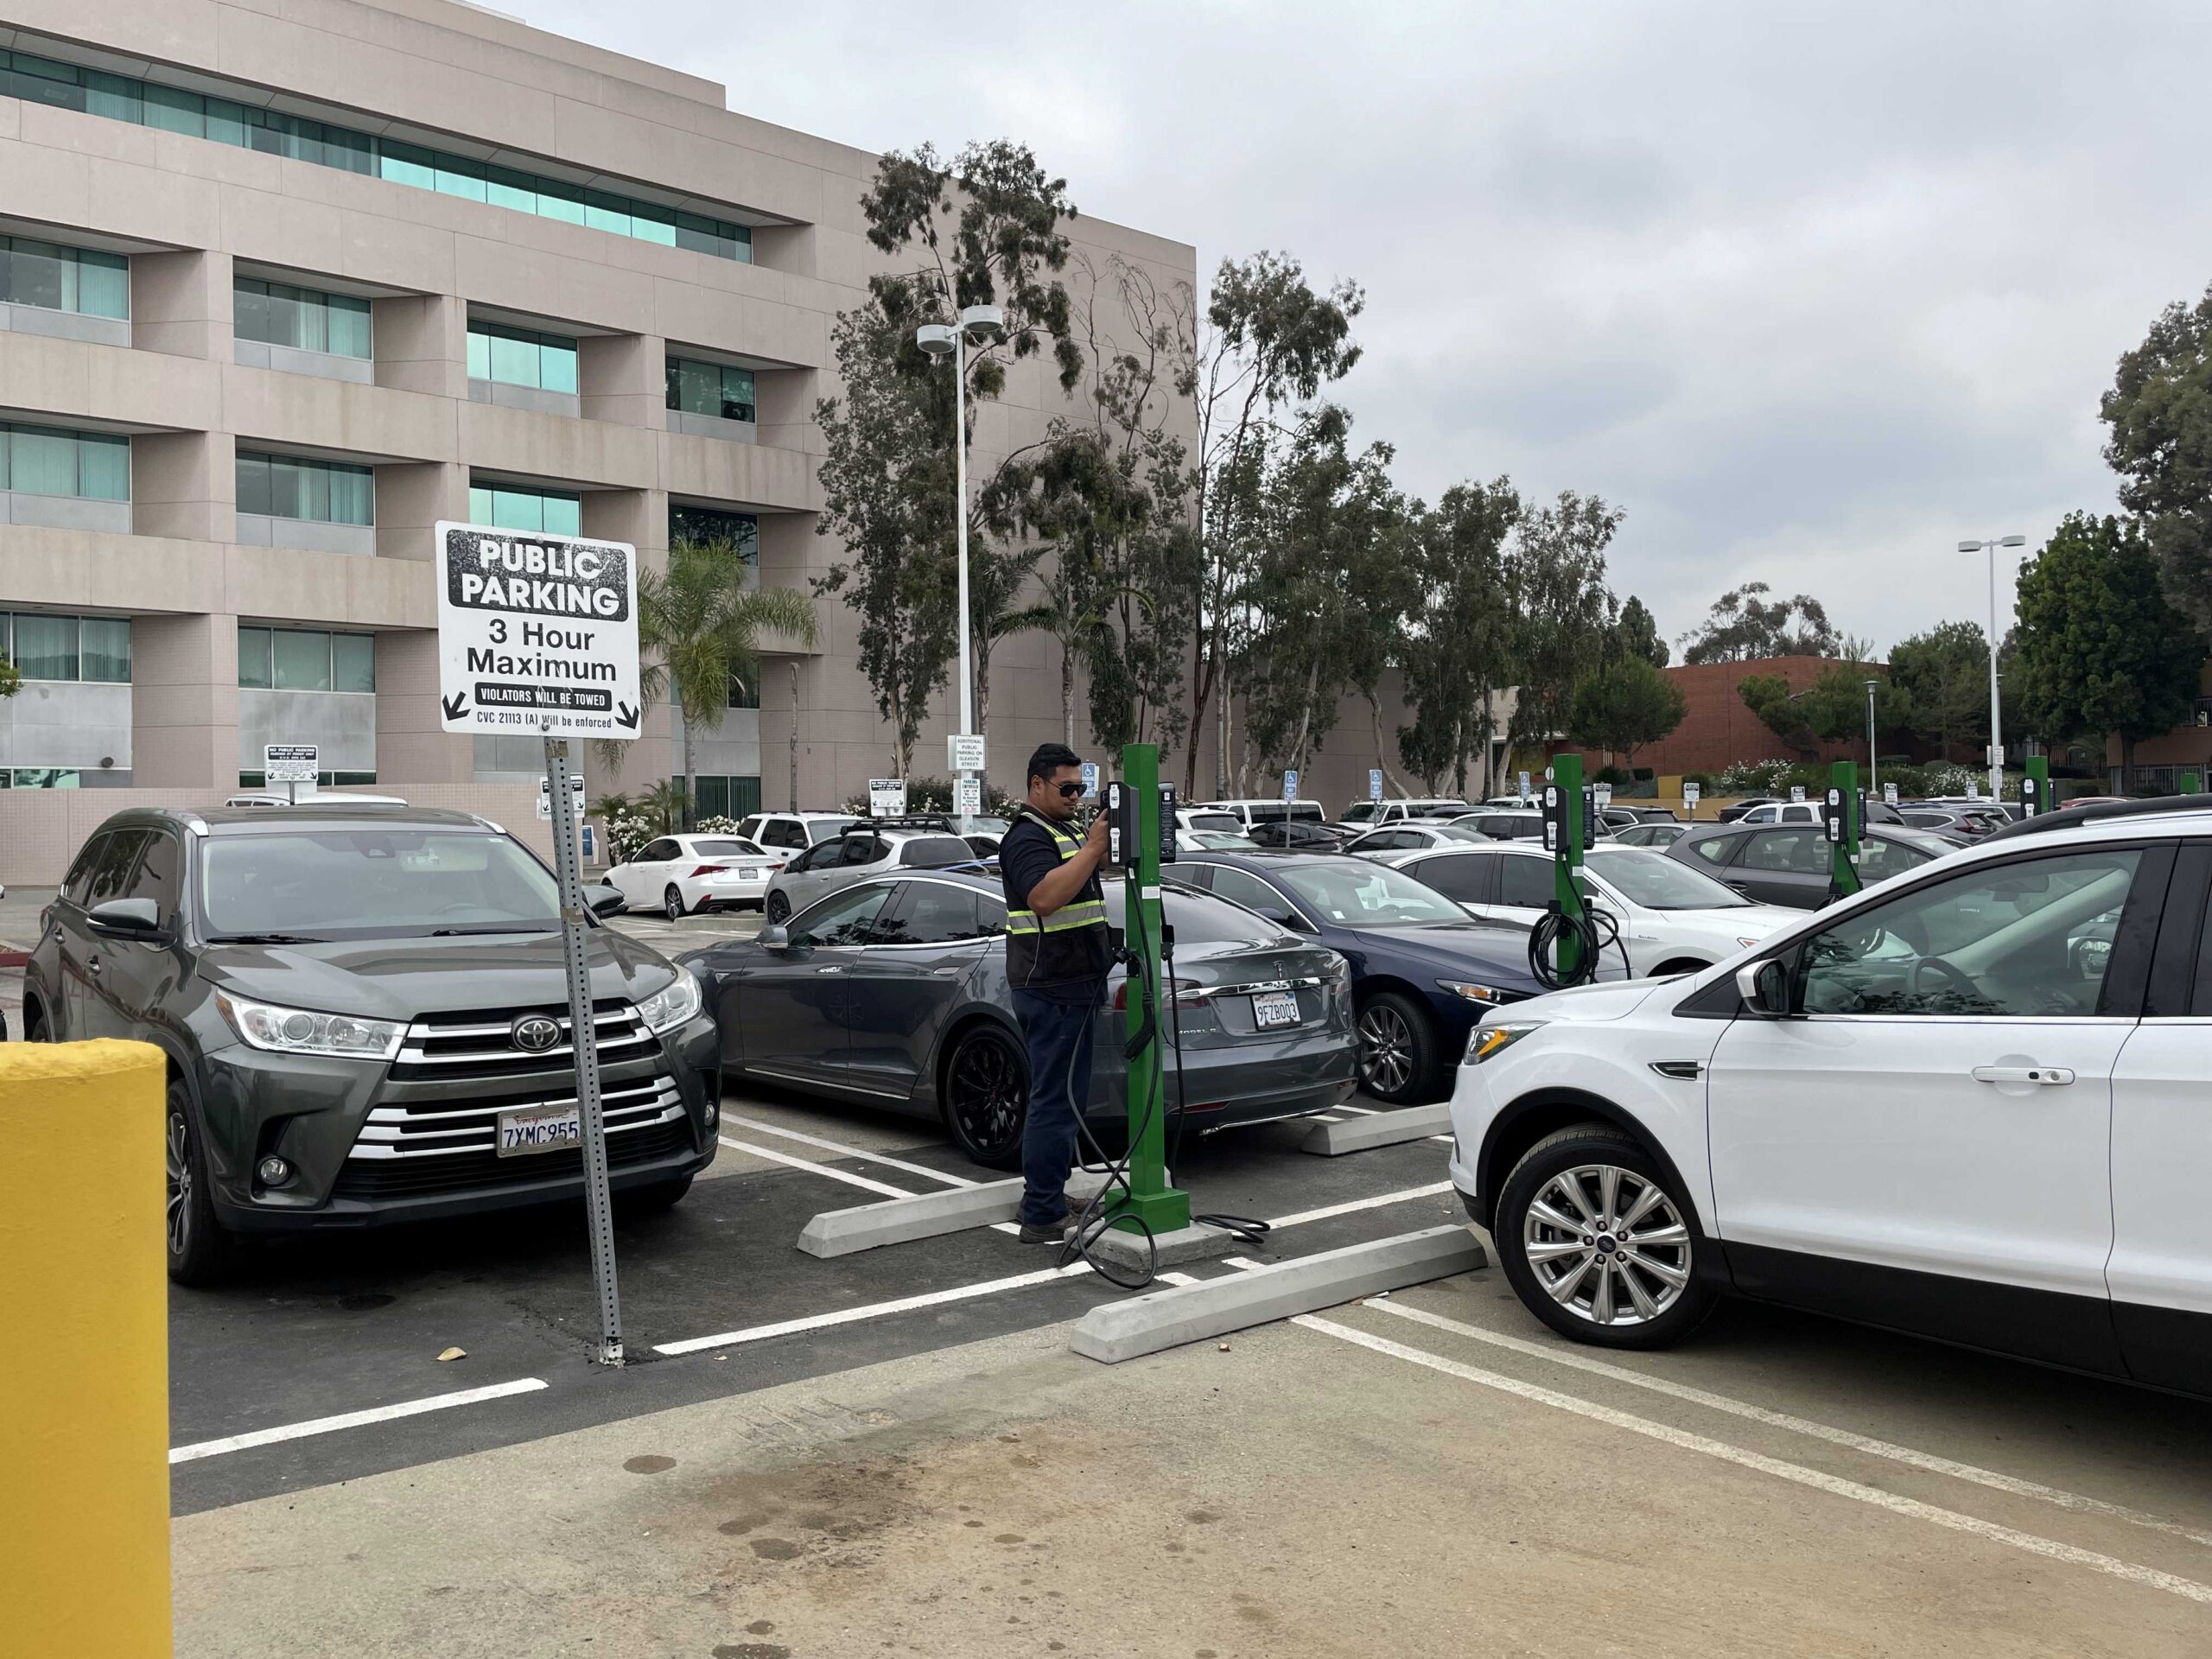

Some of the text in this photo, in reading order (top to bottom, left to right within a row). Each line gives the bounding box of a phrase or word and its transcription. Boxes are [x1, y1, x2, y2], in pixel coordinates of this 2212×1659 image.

[480, 539, 602, 580] PUBLIC
[461, 573, 620, 616] PARKING
[489, 619, 595, 650] 3 Hour
[467, 647, 616, 681] Maximum
[480, 688, 605, 707] VIOLATORS WILL BE TOWED
[477, 711, 612, 728] CVC 21113 (A) Will be enforced
[1257, 1002, 1297, 1022] 9FZB003
[504, 1121, 578, 1147] 7XMC955
